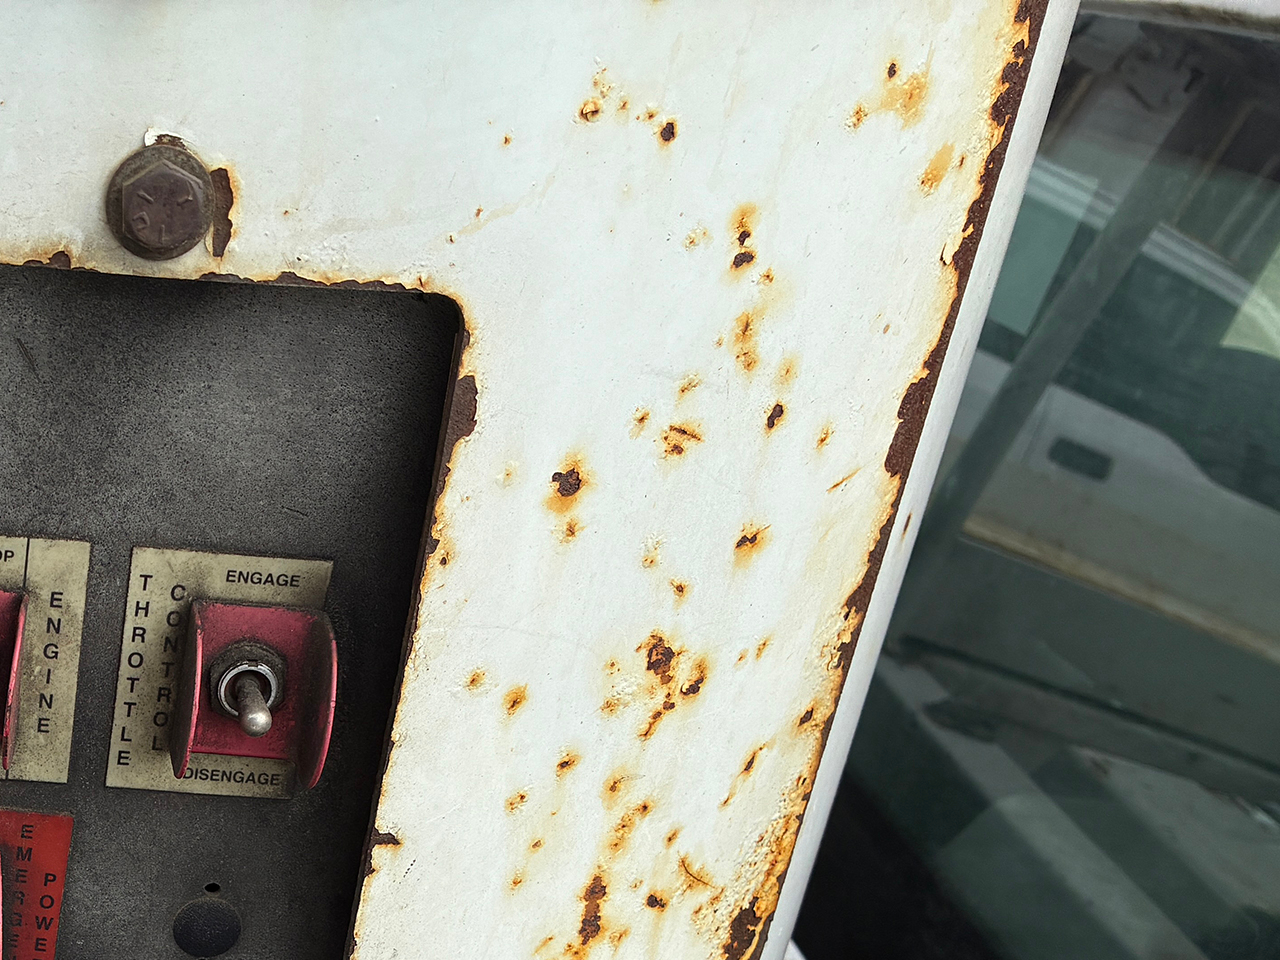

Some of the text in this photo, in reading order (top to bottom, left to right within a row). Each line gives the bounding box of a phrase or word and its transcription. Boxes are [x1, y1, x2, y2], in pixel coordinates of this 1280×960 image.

[225, 569, 301, 588] ENGAGE
[37, 591, 64, 734] ENGINE
[116, 574, 153, 766] THROTTLE
[151, 584, 187, 751] CONTROL
[183, 767, 281, 786] DISENGAGE
